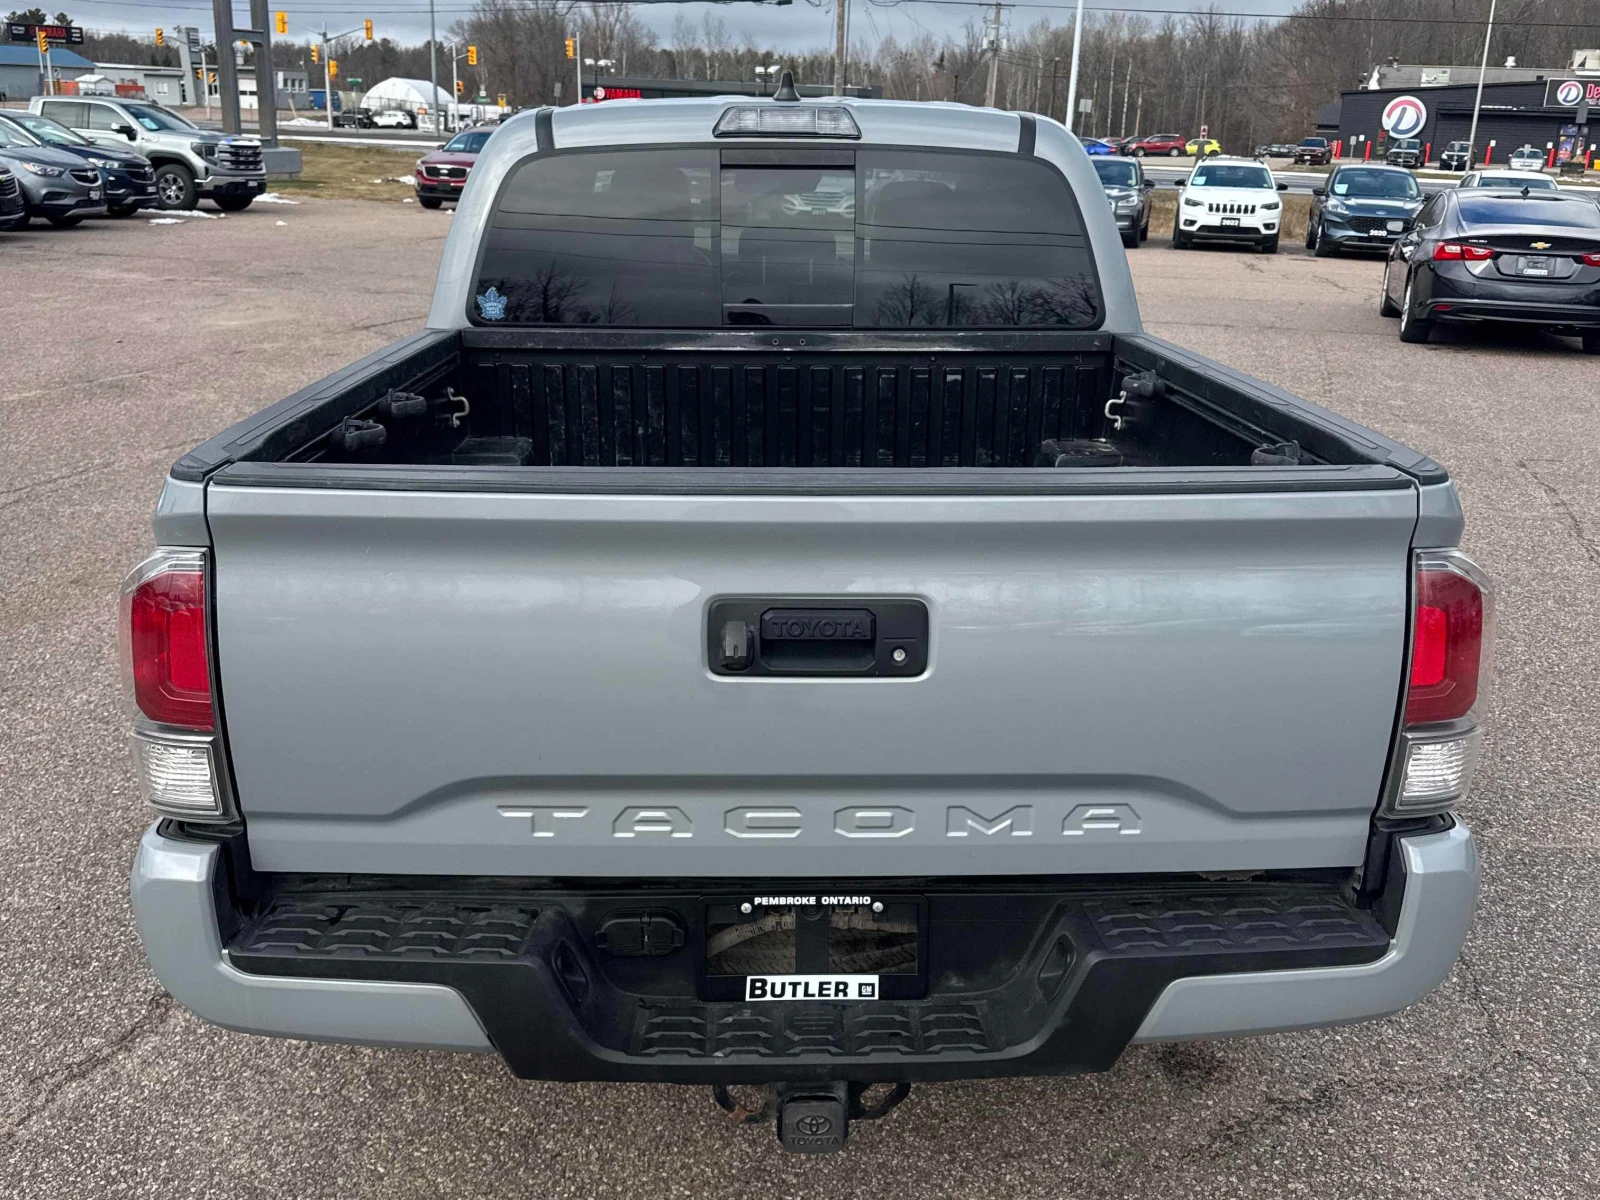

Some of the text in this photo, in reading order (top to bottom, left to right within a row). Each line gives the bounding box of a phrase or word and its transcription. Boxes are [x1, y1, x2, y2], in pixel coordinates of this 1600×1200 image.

[605, 88, 643, 99] YAMAHA
[1369, 229, 1388, 237] 2020
[772, 619, 867, 638] TOYOTA
[496, 803, 1143, 838] TACOMA
[754, 896, 872, 906] PEMBROKE ONTARIO
[748, 978, 849, 1000] BUTLER
[789, 1135, 840, 1146] TOYOTA
